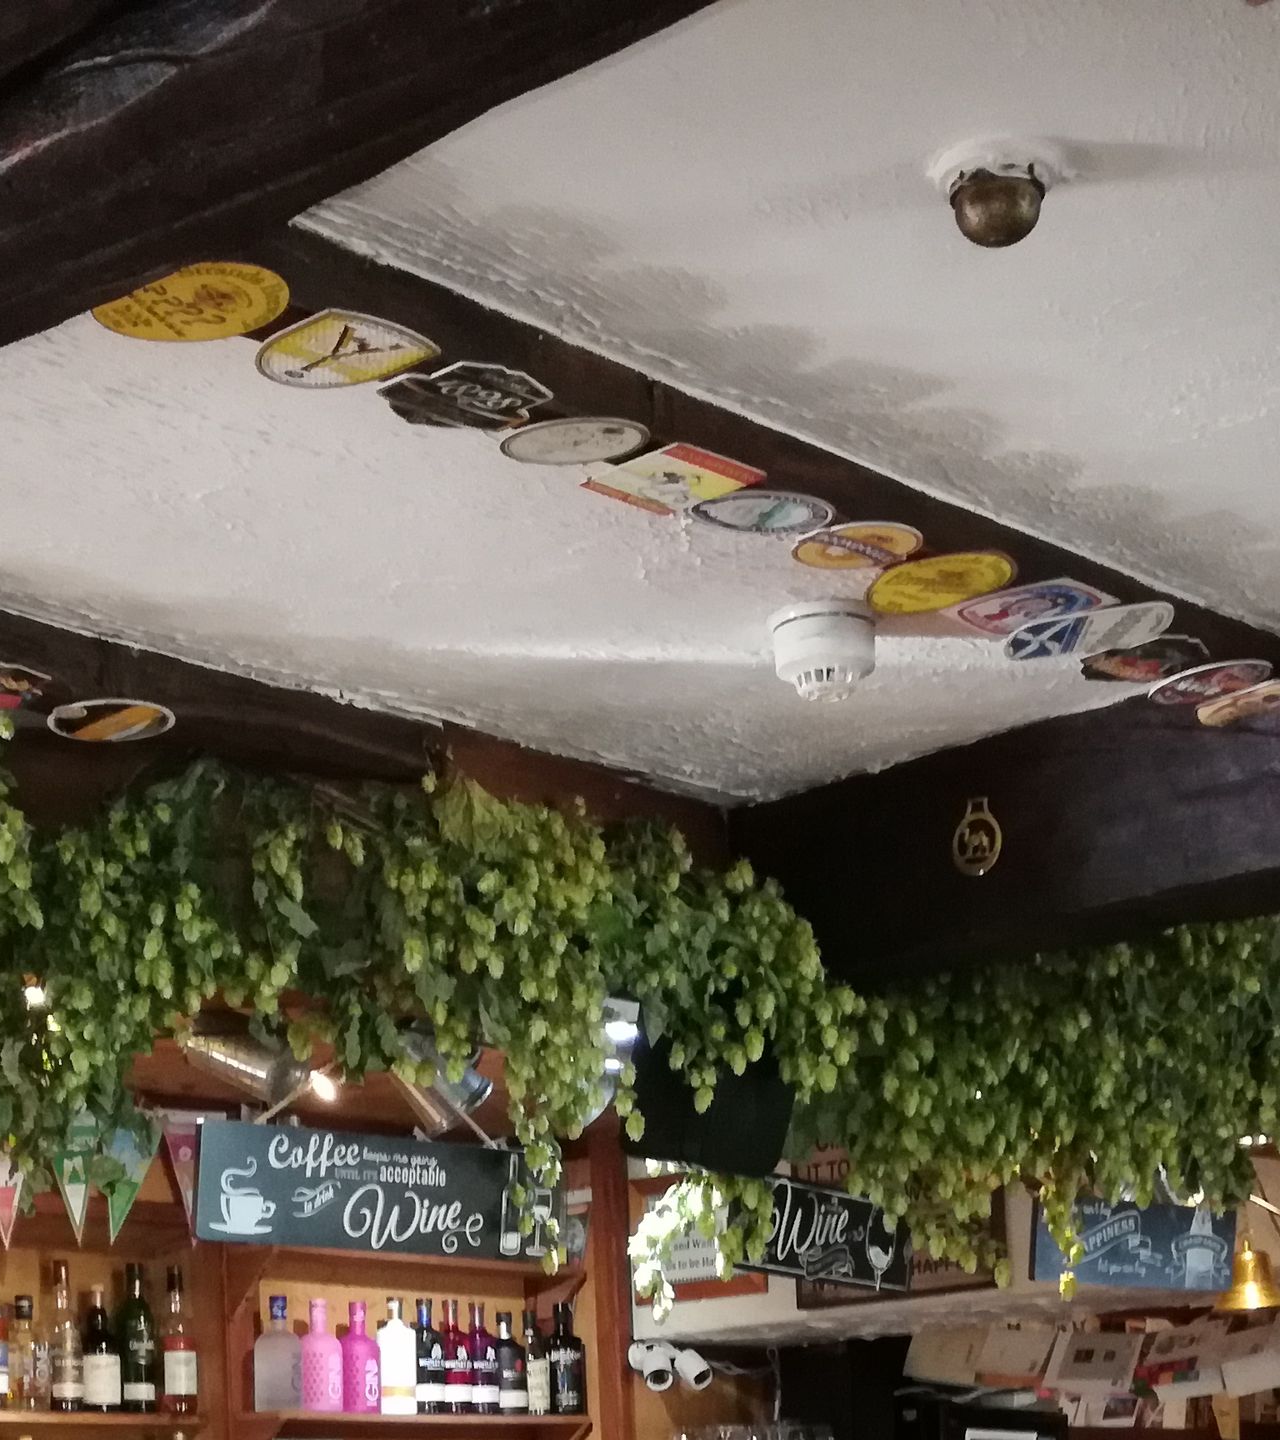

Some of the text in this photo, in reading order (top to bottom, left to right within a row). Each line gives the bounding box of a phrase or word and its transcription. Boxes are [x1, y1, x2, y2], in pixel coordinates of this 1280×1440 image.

[268, 1133, 361, 1178] Coffee
[828, 1160, 851, 1181] TO
[380, 1165, 447, 1188] acceptable
[343, 1183, 475, 1251] Wine
[766, 1178, 850, 1261] Wine
[1084, 1218, 1136, 1252] APPINESS
